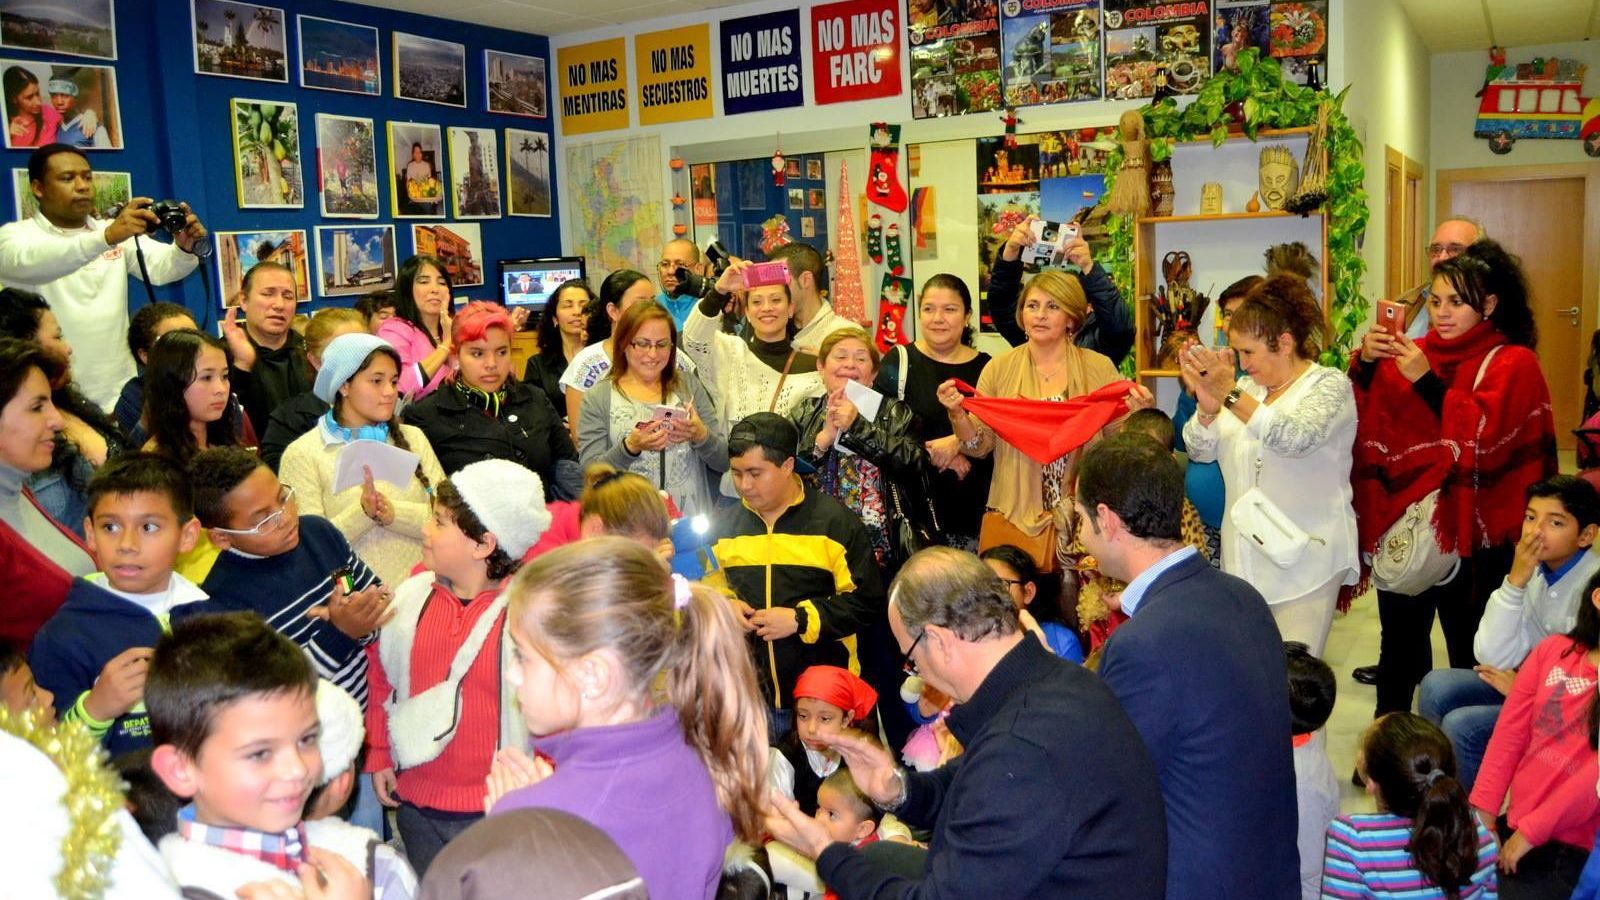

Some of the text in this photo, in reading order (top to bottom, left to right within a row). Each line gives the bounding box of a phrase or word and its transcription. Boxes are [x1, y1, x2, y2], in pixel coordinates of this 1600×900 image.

[1124, 1, 1208, 22] COLOMBIA
[730, 26, 792, 62] NO MAS
[818, 9, 895, 52] NO MAS
[568, 58, 618, 87] NO MAS
[651, 44, 694, 74] NO MAS
[830, 50, 882, 88] FARC
[642, 77, 708, 108] SECUESTROS
[727, 64, 799, 99] MUERTES
[563, 89, 626, 117] MENTIRAS
